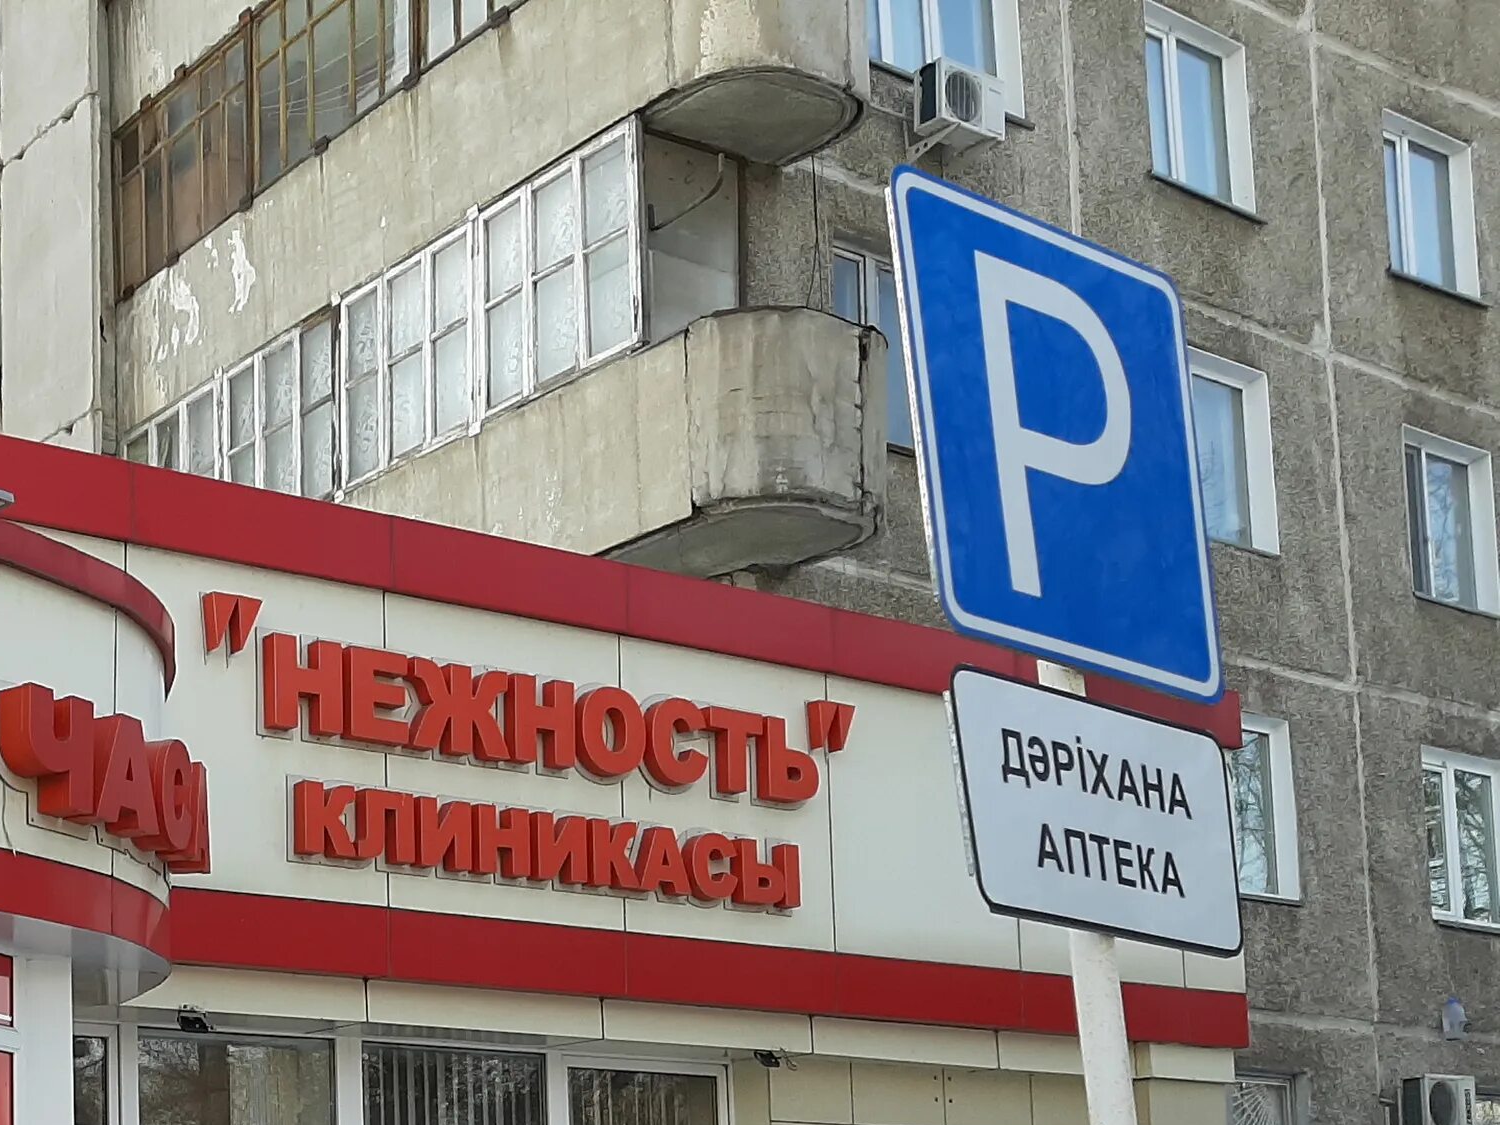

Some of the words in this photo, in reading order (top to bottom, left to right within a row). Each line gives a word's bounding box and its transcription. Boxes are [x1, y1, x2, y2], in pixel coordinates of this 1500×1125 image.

[973, 250, 1132, 598] P
[293, 778, 800, 910] КЛИНИКАСЫ
[1036, 822, 1185, 899] АПТЕКА
